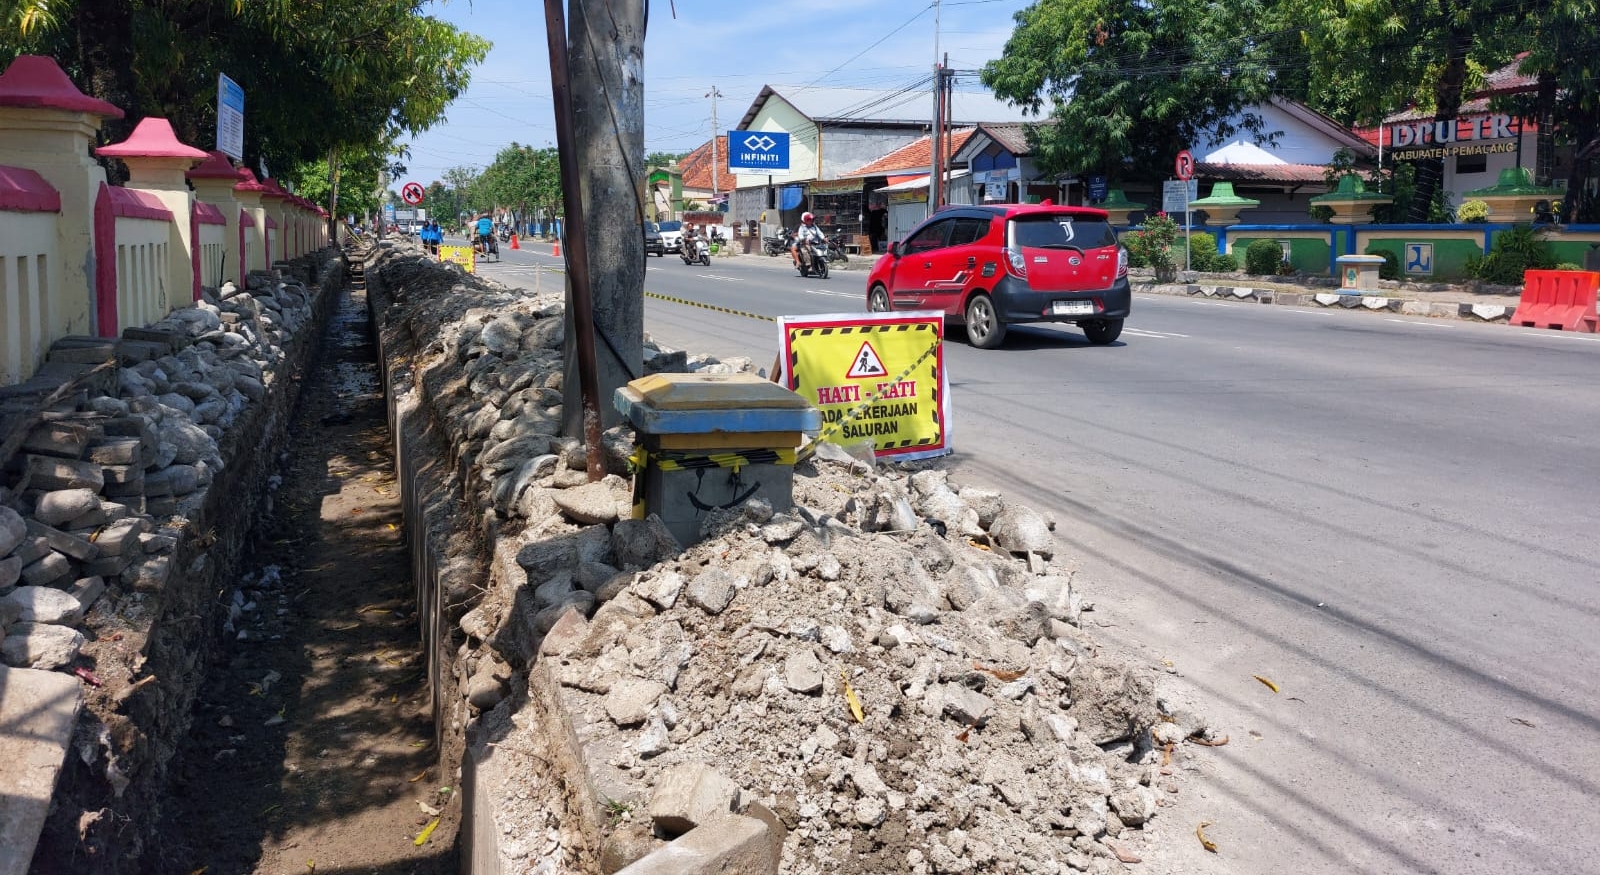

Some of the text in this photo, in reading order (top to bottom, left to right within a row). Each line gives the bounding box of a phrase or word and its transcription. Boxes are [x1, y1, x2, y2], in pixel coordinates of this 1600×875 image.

[741, 153, 779, 161] INFINITI
[1391, 142, 1514, 161] KABUPATEN PEMALANG
[817, 386, 860, 404] HATI
[821, 403, 917, 423] ADA EKERJAAN
[843, 421, 898, 438] SALURAN
